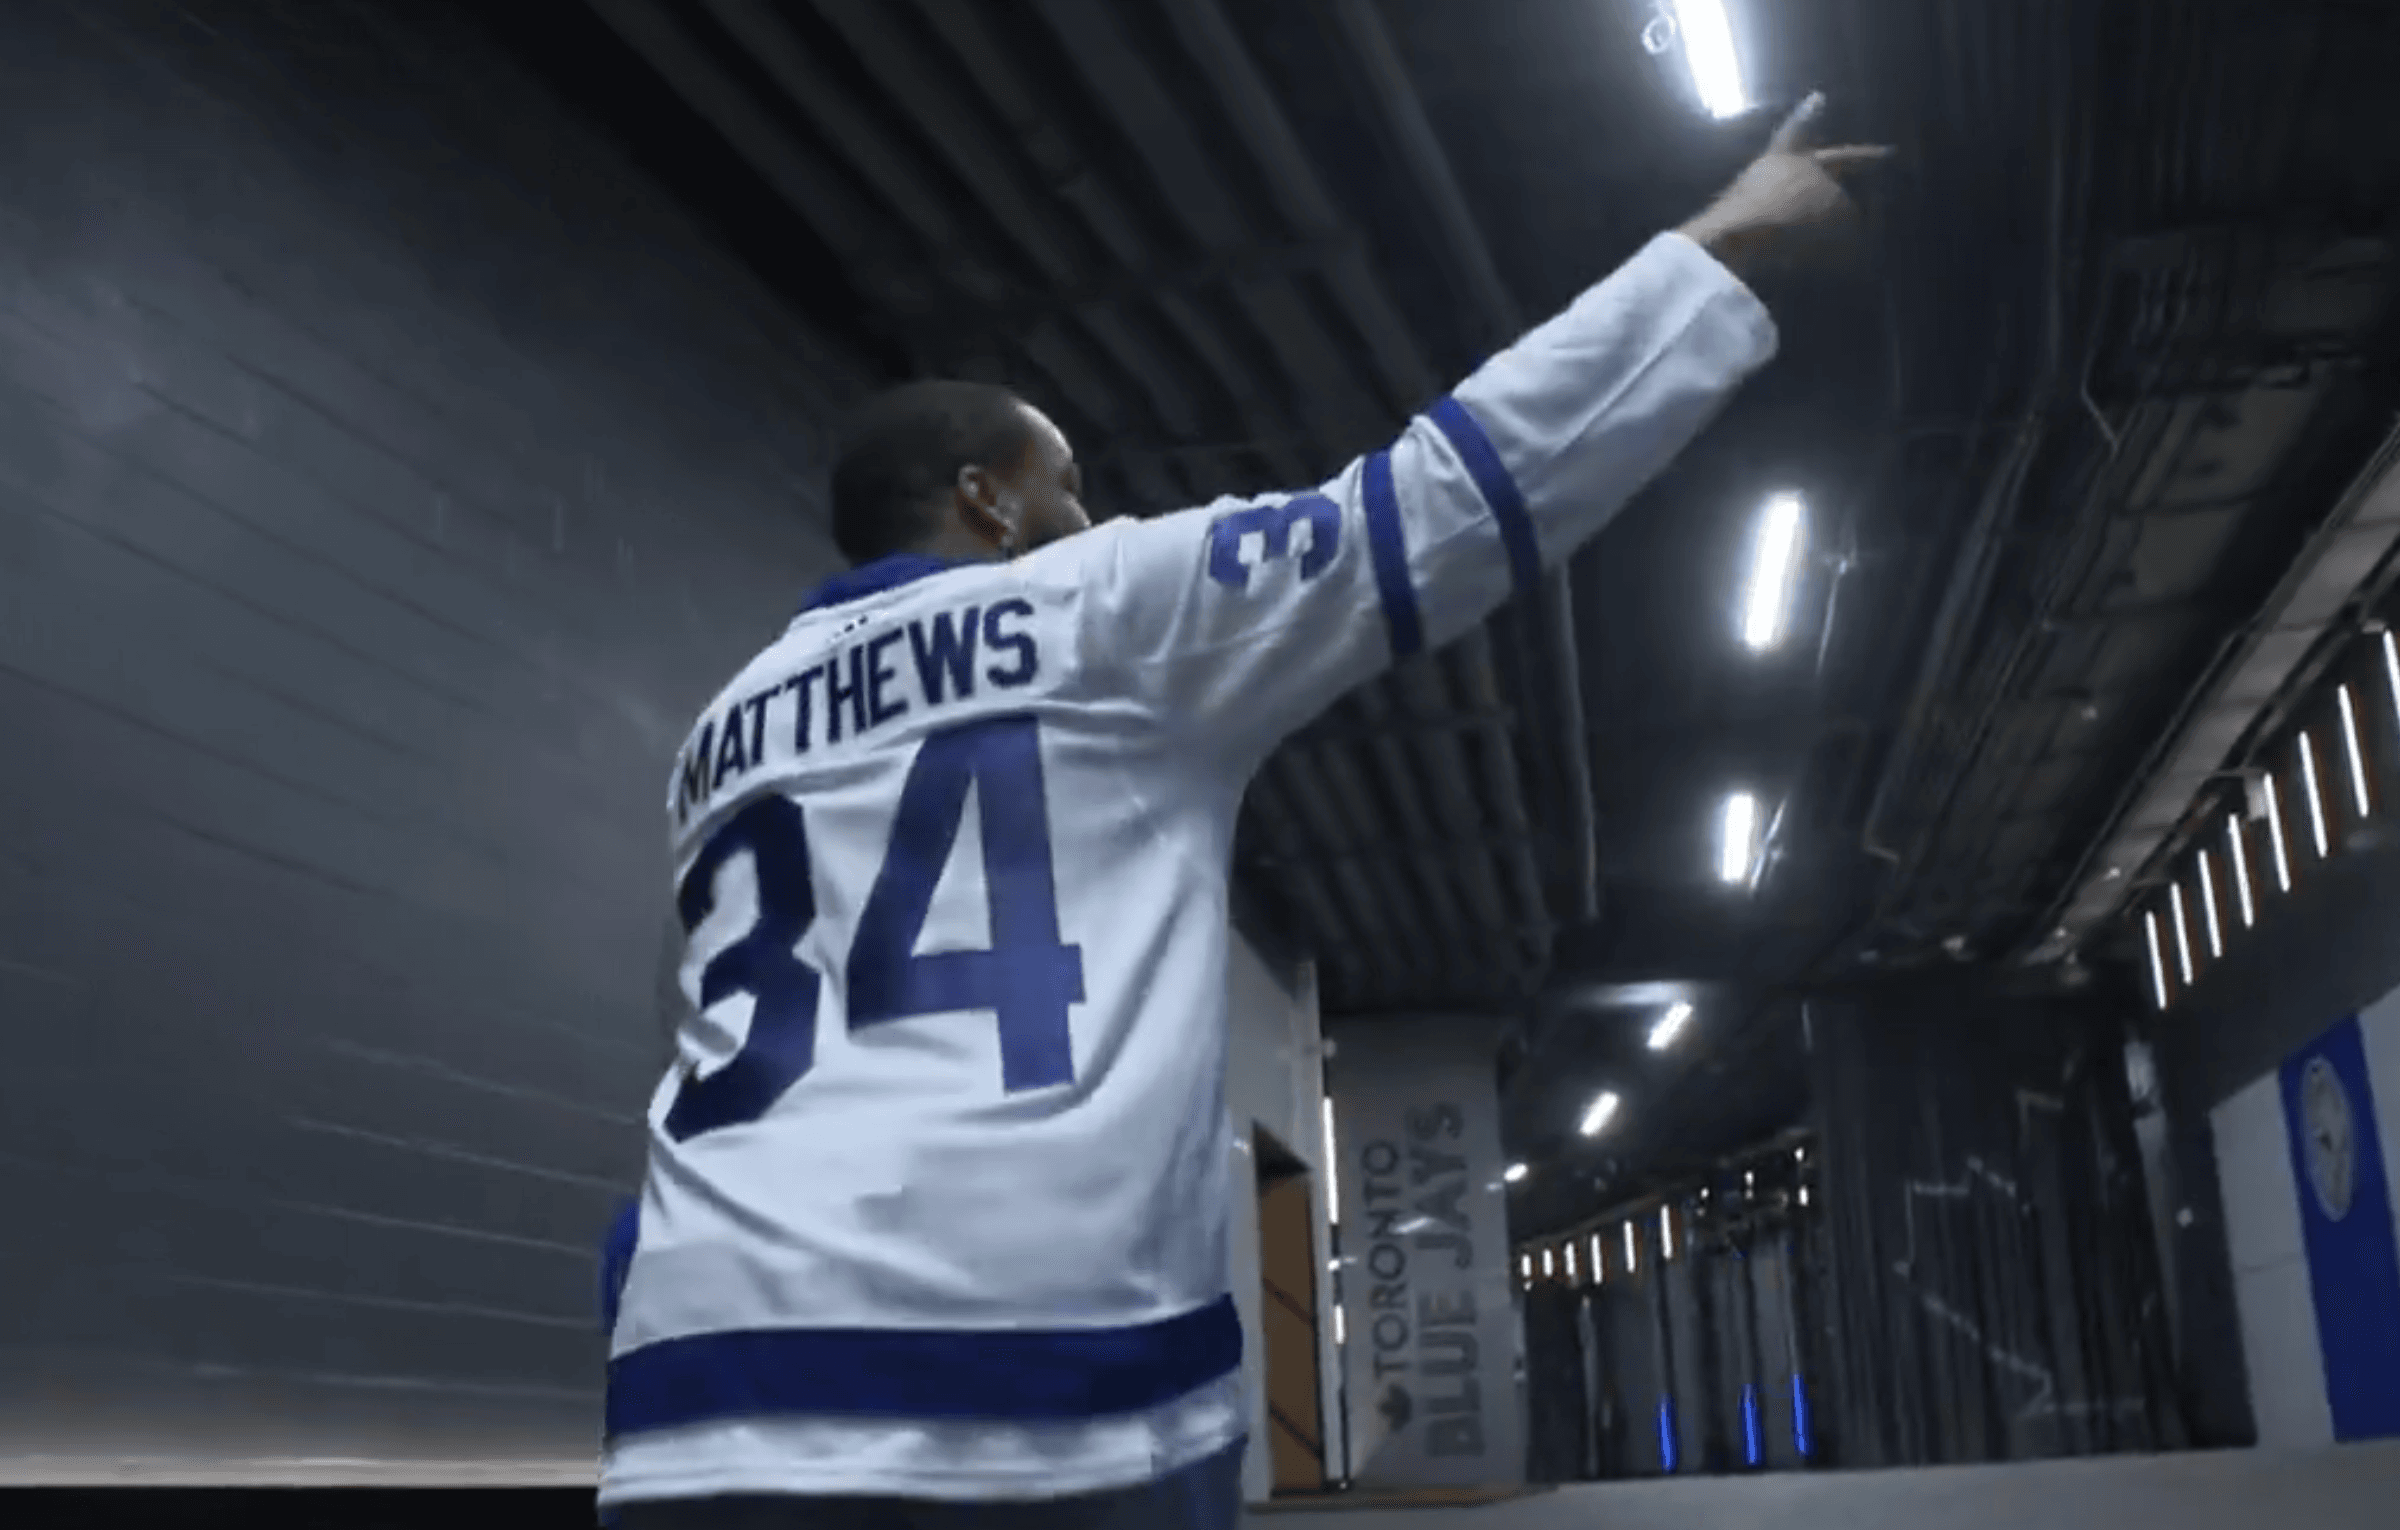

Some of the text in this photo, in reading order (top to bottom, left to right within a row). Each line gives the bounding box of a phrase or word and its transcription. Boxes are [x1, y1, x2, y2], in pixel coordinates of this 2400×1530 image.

[678, 599, 1039, 825] MATTHEWS
[664, 712, 1087, 1144] 34
[1361, 1139, 1409, 1380] TORONTO
[1407, 1103, 1486, 1458] BLUE JAYS
